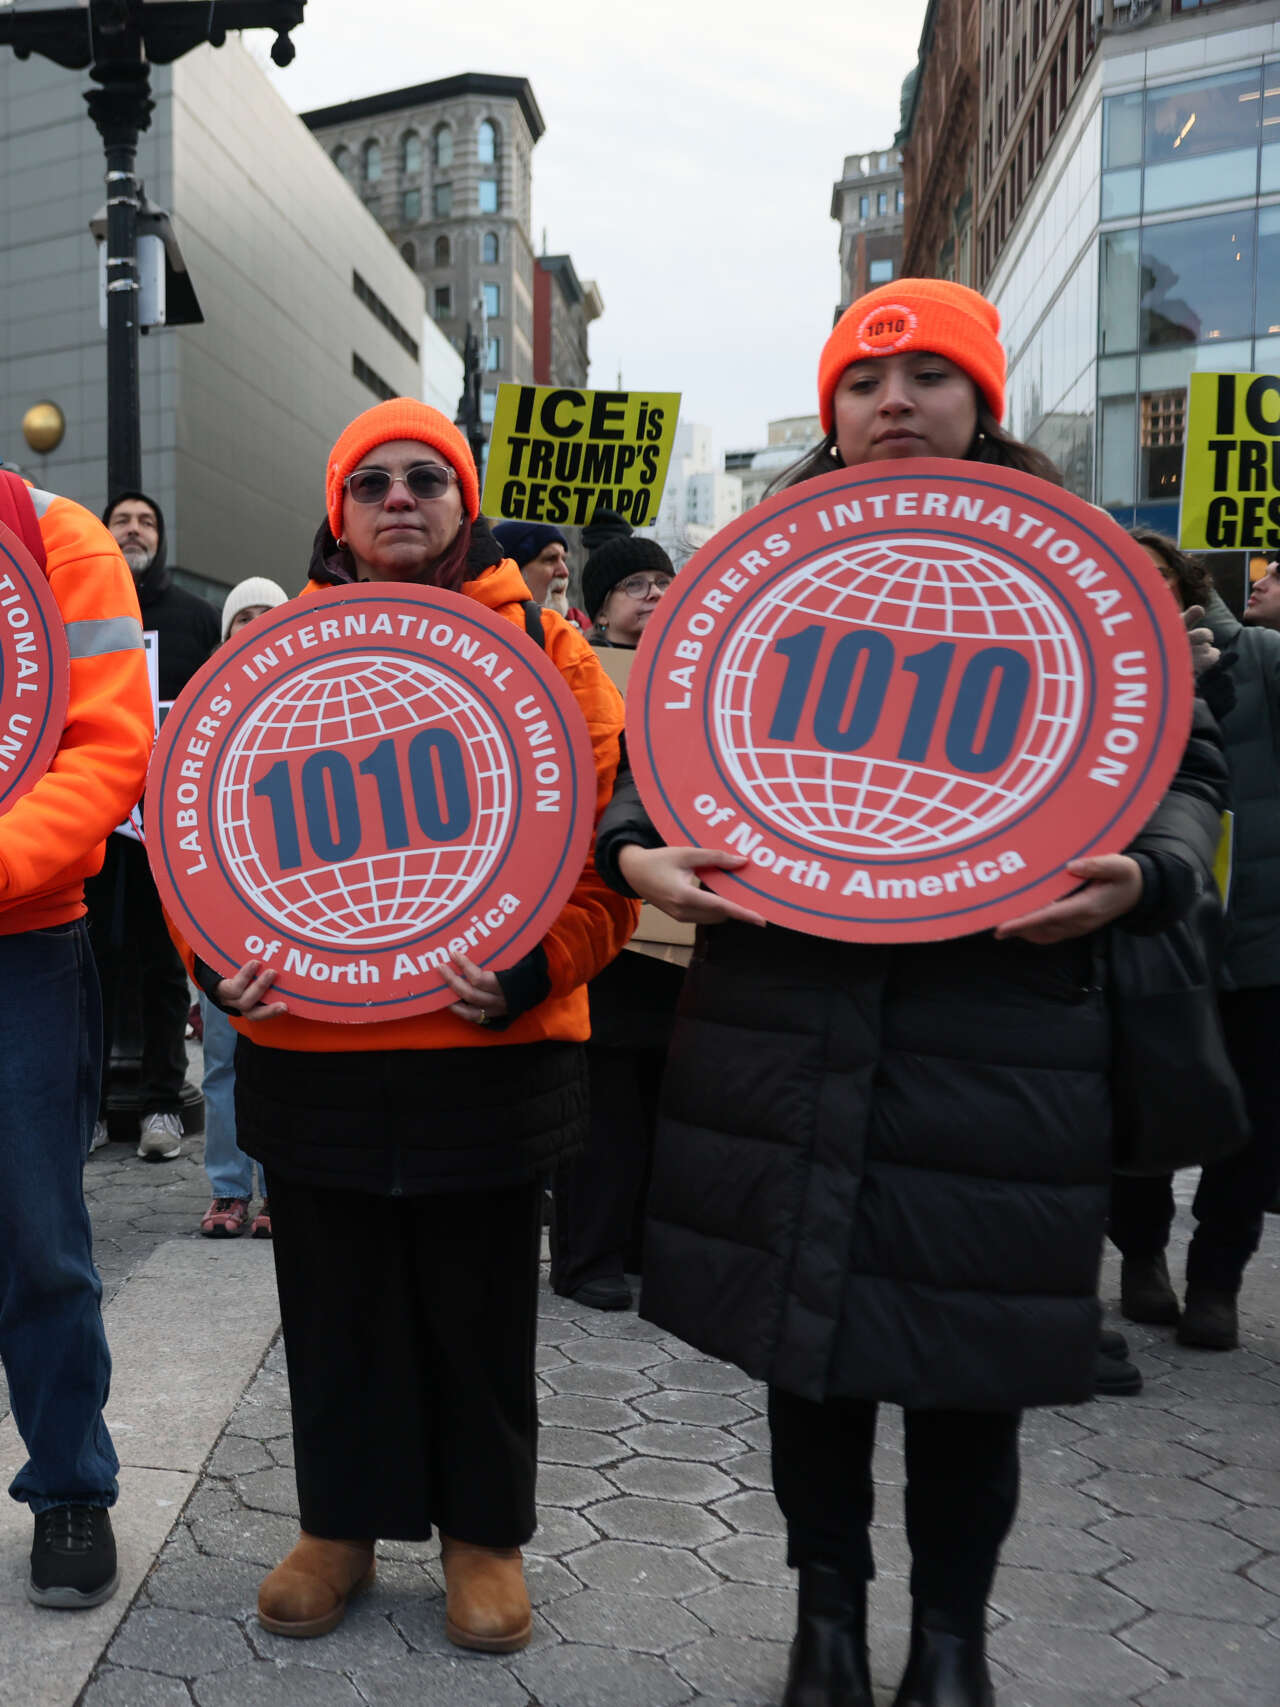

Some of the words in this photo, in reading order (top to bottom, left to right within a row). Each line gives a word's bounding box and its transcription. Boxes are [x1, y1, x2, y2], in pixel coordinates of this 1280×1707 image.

[867, 319, 905, 337] 1010
[507, 436, 660, 485] TRUMP'S
[515, 386, 629, 440] ICE
[636, 402, 664, 441] is
[501, 480, 651, 527] GESTAPO
[665, 523, 798, 710] LABORERS'
[817, 492, 1133, 636] INTERNATIONAL
[1088, 650, 1147, 787] UNION
[176, 683, 232, 875] LABORERS'
[242, 613, 513, 691] INTERNATIONAL
[515, 695, 560, 813] UNION
[767, 624, 1031, 774] 1010
[254, 727, 471, 871] 1010
[694, 794, 736, 827] of
[724, 821, 831, 891] North
[842, 849, 1026, 900] America
[244, 935, 283, 961] of
[284, 947, 380, 984] North
[393, 893, 520, 980] America
